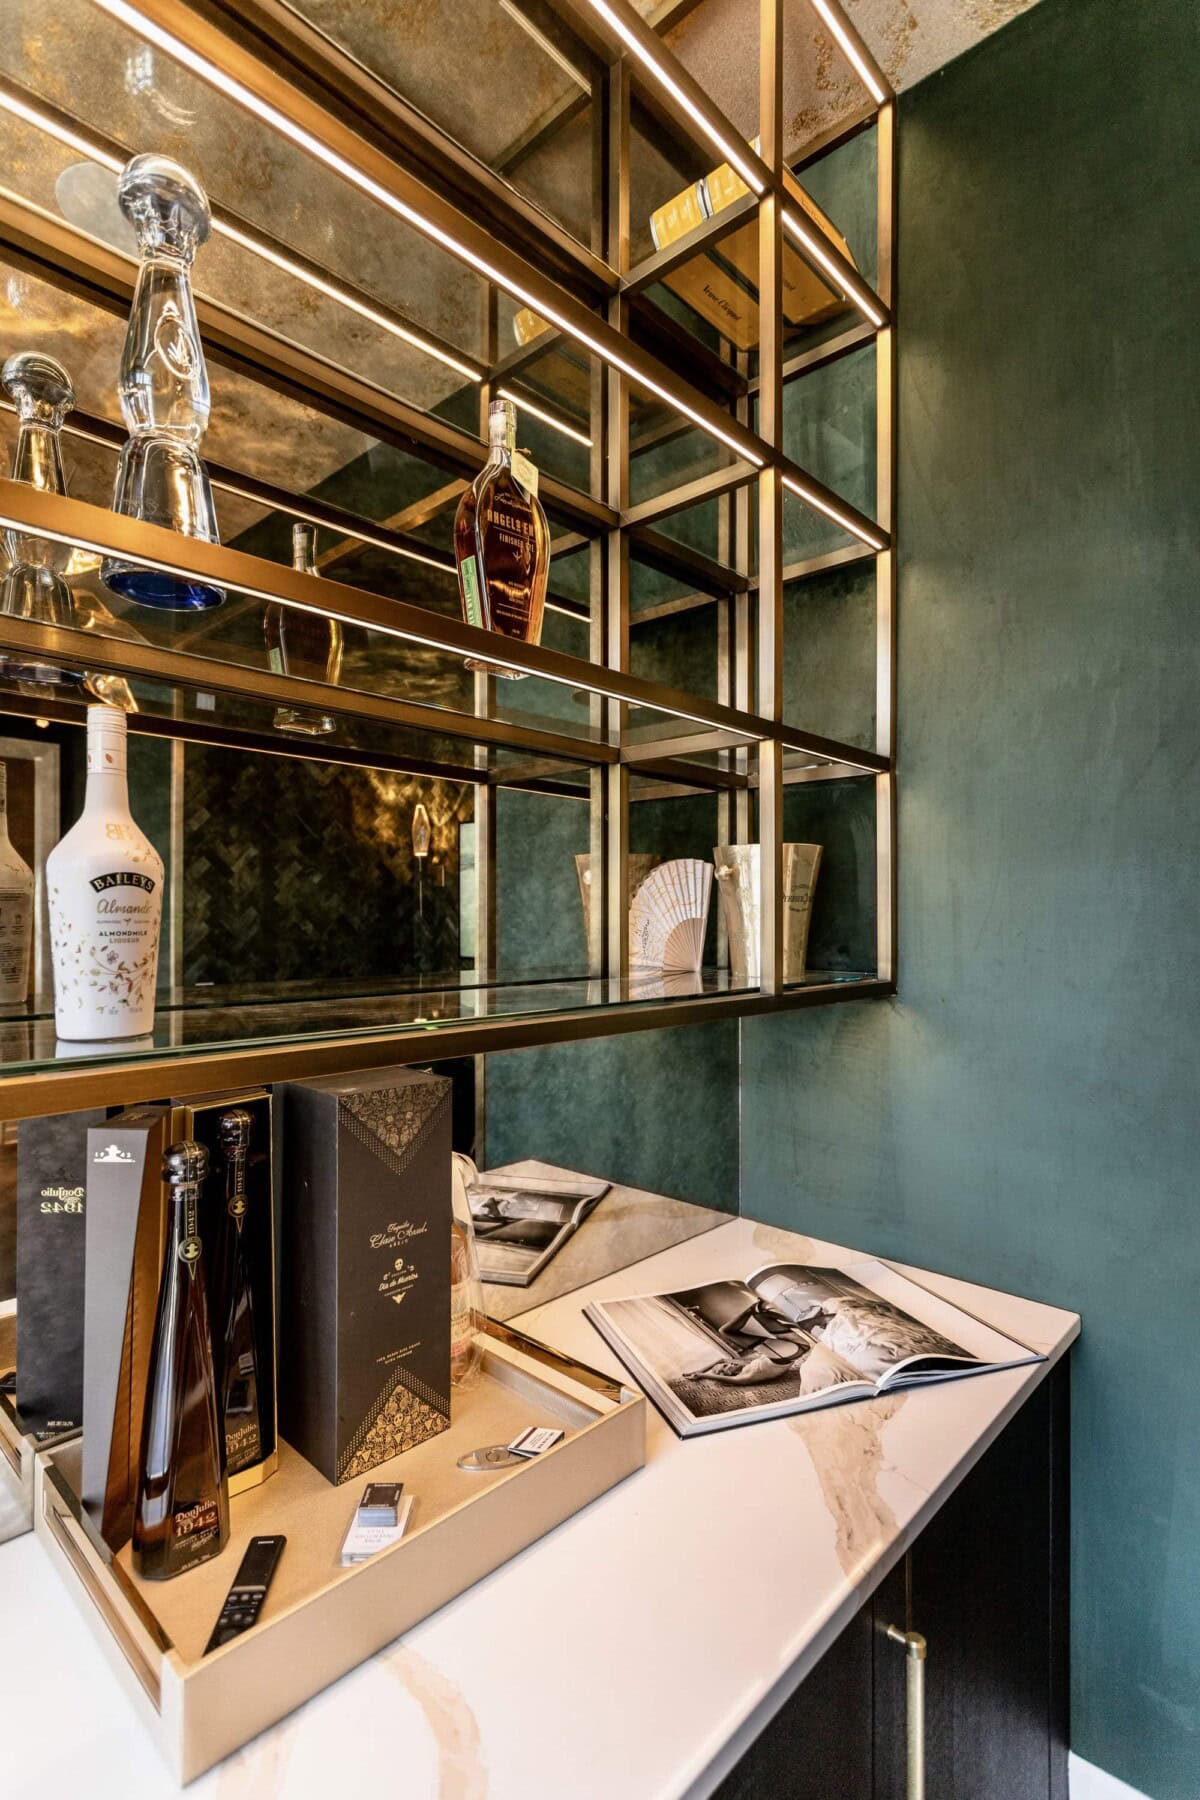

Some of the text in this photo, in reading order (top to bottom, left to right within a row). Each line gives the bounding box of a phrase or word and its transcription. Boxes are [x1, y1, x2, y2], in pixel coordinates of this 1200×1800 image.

[93, 872, 154, 891] BAILEYS
[98, 929, 148, 937] ALMONDMILK
[175, 1511, 218, 1537] 1942
